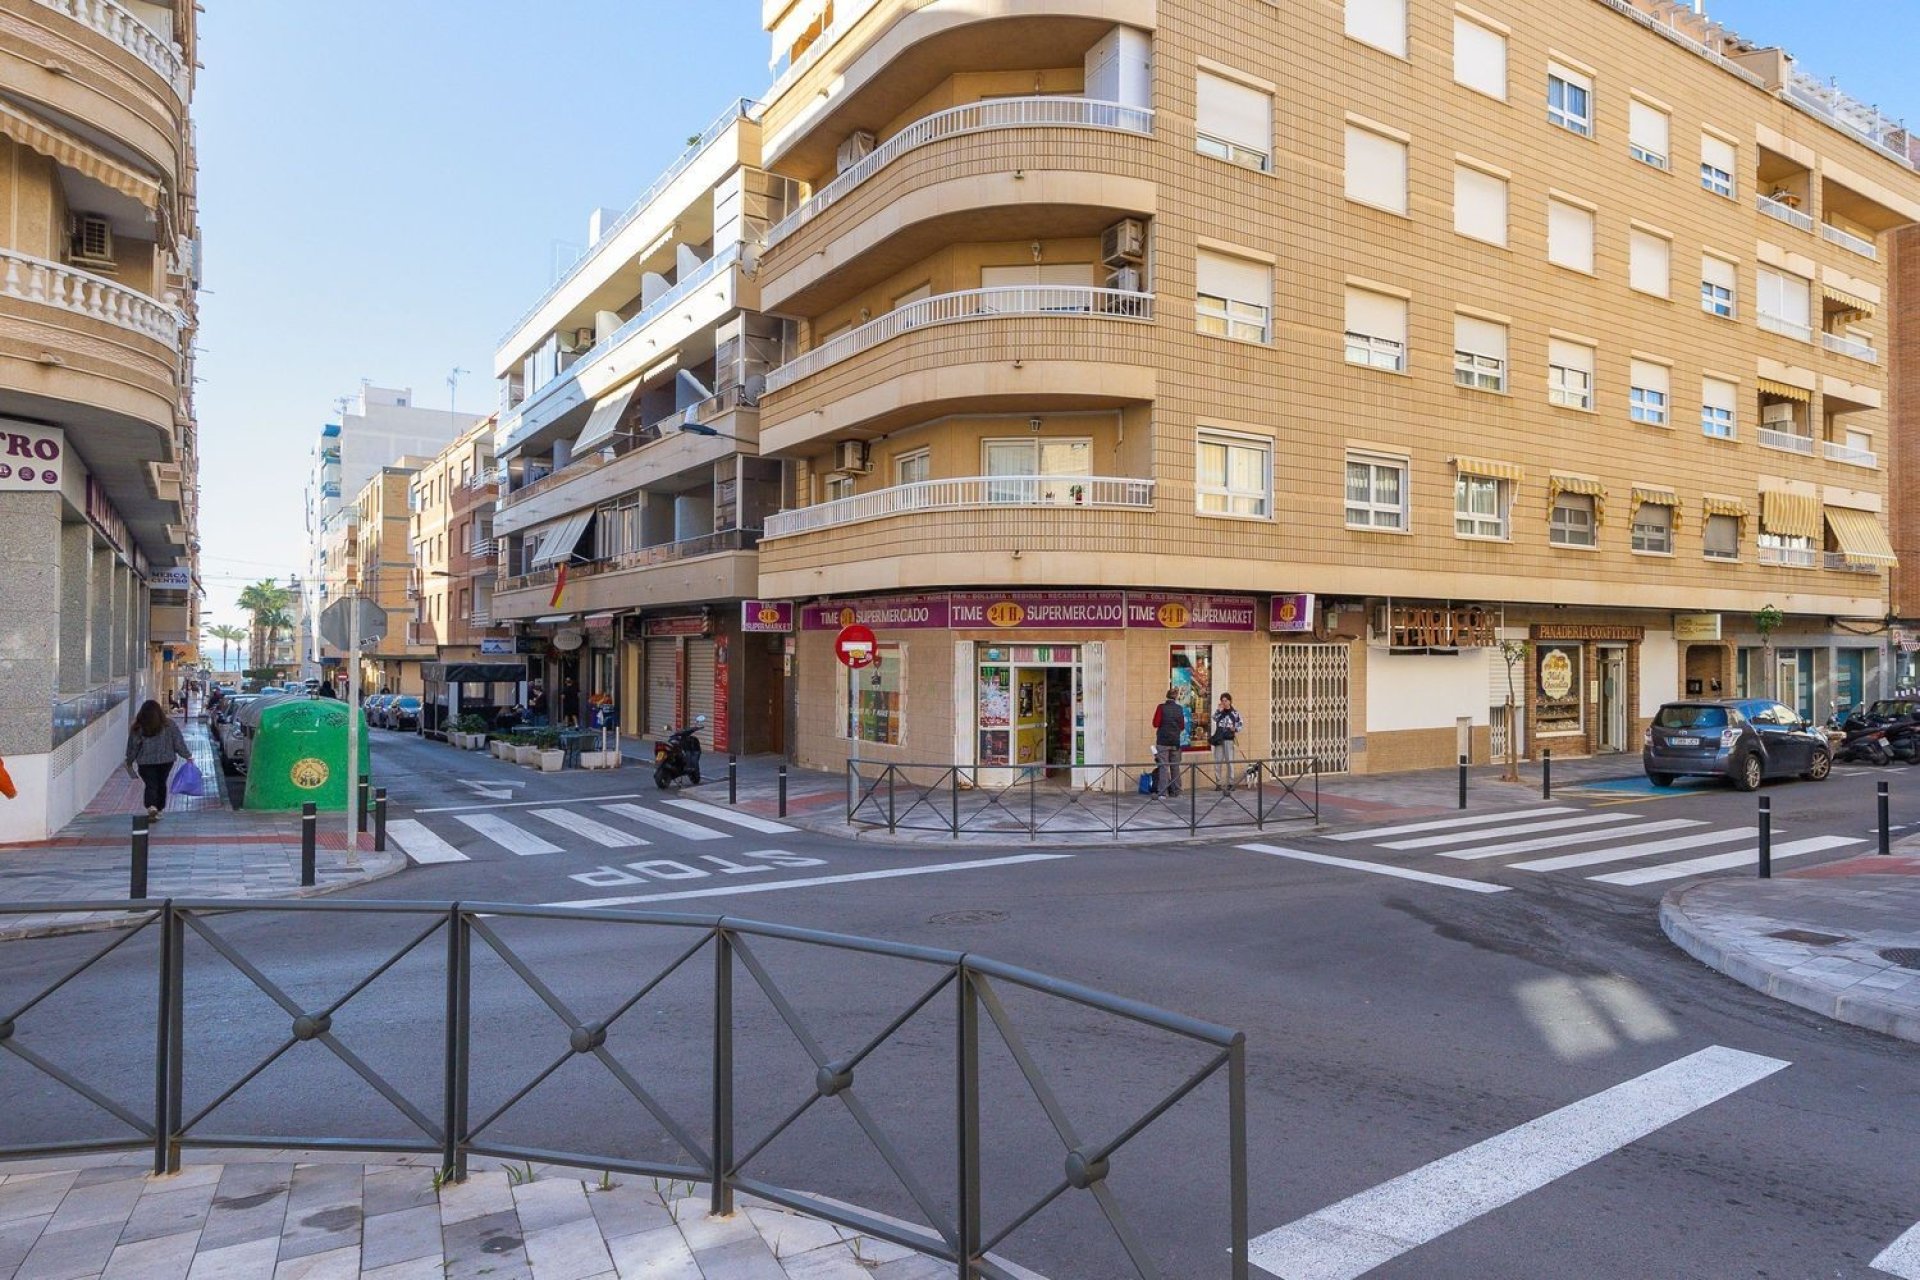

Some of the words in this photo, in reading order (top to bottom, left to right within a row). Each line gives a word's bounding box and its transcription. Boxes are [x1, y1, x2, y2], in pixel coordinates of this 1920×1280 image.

[0, 432, 60, 460] RO
[820, 612, 838, 625] TIME
[855, 608, 929, 623] SUPERMERCADO
[952, 606, 982, 621] TIME
[991, 607, 1004, 621] 24
[1027, 605, 1122, 621] SUPERMERCADO
[1128, 605, 1155, 621] TIME
[1161, 607, 1174, 622] 24
[1192, 609, 1253, 624] SUPERMARKET
[1540, 625, 1588, 639] PANADERIA
[1590, 626, 1641, 640] CONFITERIA
[568, 849, 829, 887] STOP
